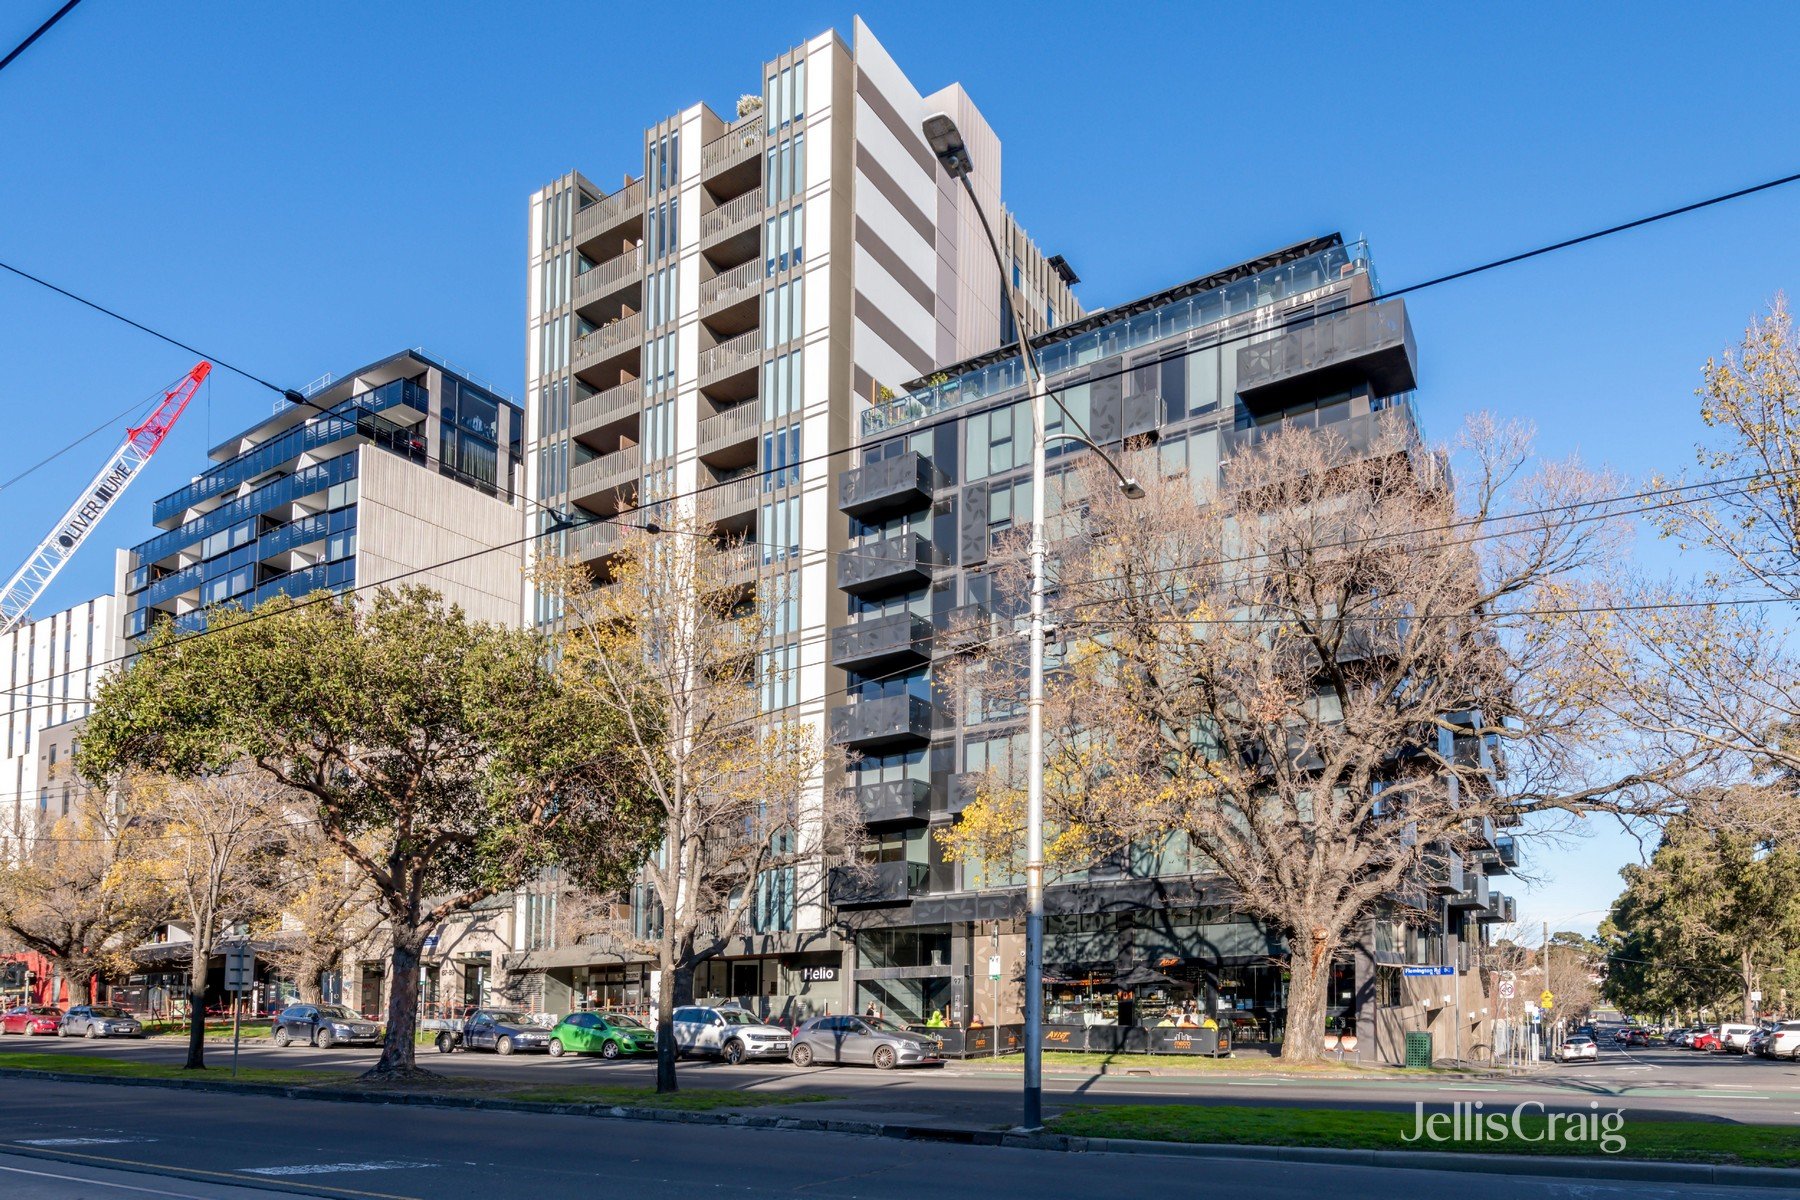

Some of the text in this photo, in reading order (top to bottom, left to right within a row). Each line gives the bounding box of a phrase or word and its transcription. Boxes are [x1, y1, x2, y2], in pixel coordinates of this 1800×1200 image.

[59, 500, 104, 547] OLIVER
[804, 966, 834, 980] Helio
[1405, 967, 1433, 975] Flemington
[1118, 991, 1134, 1000] 101
